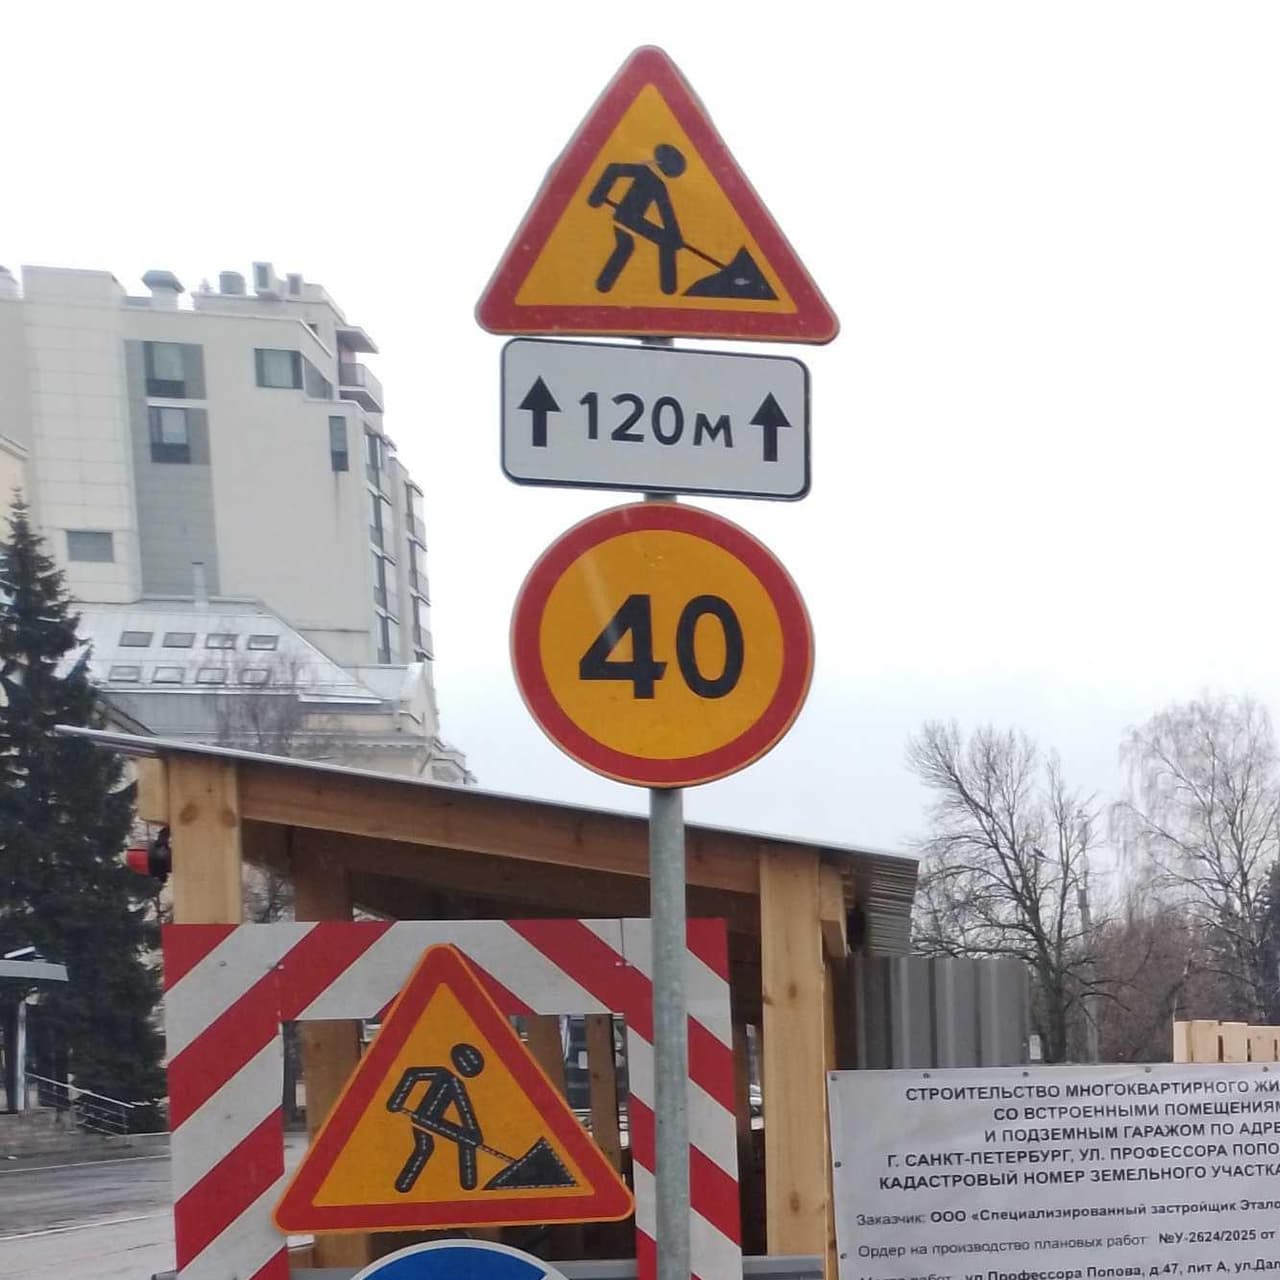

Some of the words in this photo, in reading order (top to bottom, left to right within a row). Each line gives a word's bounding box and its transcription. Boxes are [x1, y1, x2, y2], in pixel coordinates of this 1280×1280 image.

[578, 593, 746, 701] 40
[904, 1086, 1061, 1101] СТРОИТЕЛЬСТВО
[1064, 1081, 1250, 1097] МНОГОКВАРТИРНОГО
[992, 1108, 1019, 1120] СО
[1023, 1104, 1160, 1119] ВСТРОЕННЫМИ
[984, 1130, 997, 1142] И
[1001, 1127, 1119, 1143] ПОДЗЕМНЫМ
[1123, 1124, 1206, 1138] ГАРАЖОМ
[1210, 1123, 1235, 1135] ПО
[887, 1155, 900, 1167] Г.
[904, 1149, 1075, 1166] САНКТ-ПЕТЕРБУРГ,
[1078, 1148, 1106, 1161] УЛ.
[1109, 1145, 1229, 1160] ПРОФЕССОРА
[878, 1170, 1019, 1191] КАДАСТРОВЫЙ
[1023, 1171, 1086, 1184] НОМЕР
[1089, 1166, 1207, 1182] ЗЕМЕЛЬНОГО
[929, 1211, 967, 1222] ООО
[970, 1204, 1147, 1221] «Специализированный
[1150, 1201, 1237, 1215] застройщик
[857, 1245, 907, 1259] Ордер
[909, 1246, 928, 1254] на
[931, 1242, 1031, 1255] производство
[1033, 1239, 1103, 1249] плановых
[1259, 1231, 1277, 1239] от
[1086, 1267, 1147, 1277] Попова,
[1215, 1261, 1231, 1272] А,
